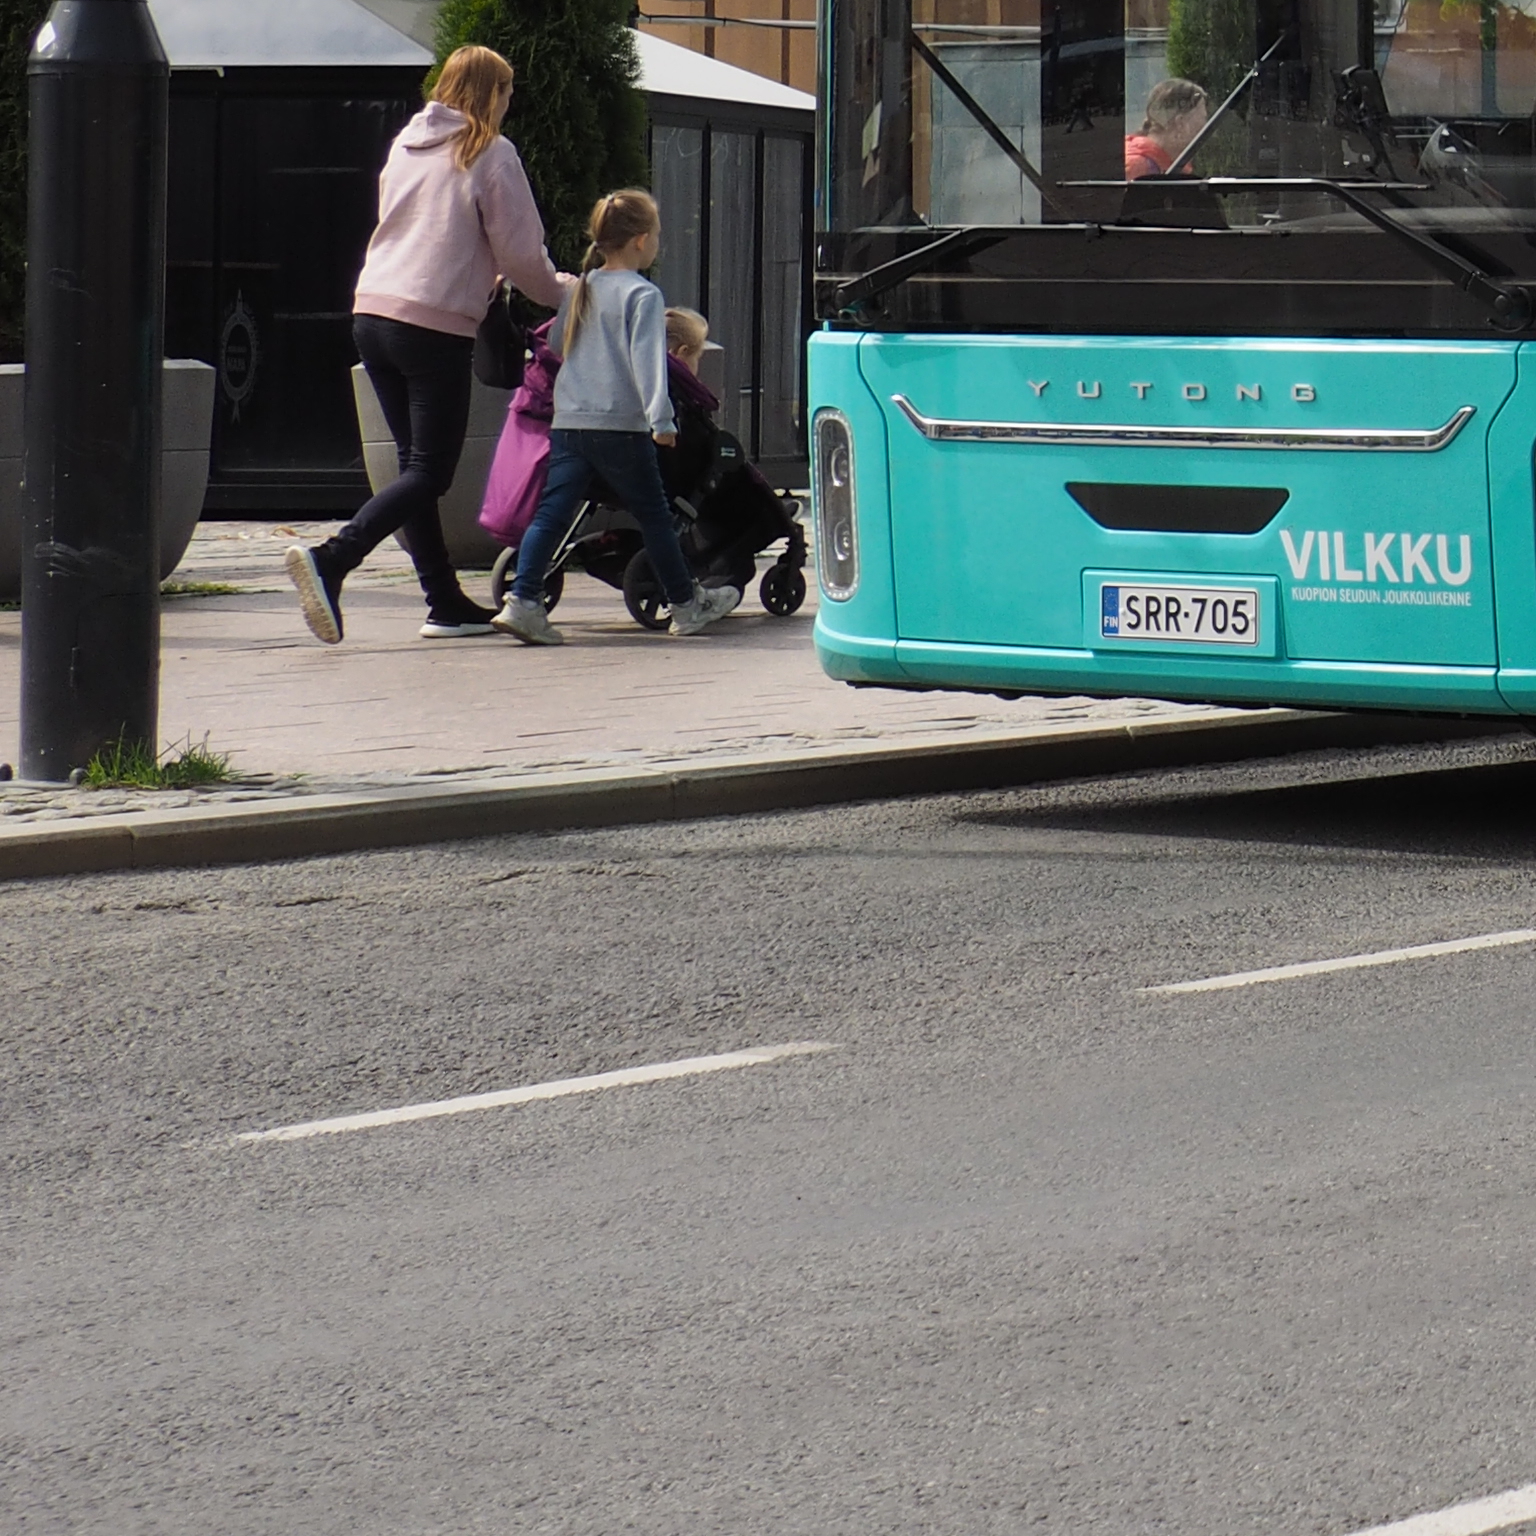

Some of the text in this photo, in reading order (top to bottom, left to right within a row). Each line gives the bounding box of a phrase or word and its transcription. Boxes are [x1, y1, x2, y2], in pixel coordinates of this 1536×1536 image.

[1027, 379, 1316, 402] YUTONG
[1279, 529, 1472, 586] VILKKU
[1291, 586, 1472, 607] KUOPION SEUDUN JOUKKOLIIKENNE
[1104, 594, 1250, 635] FIN SRR-705
